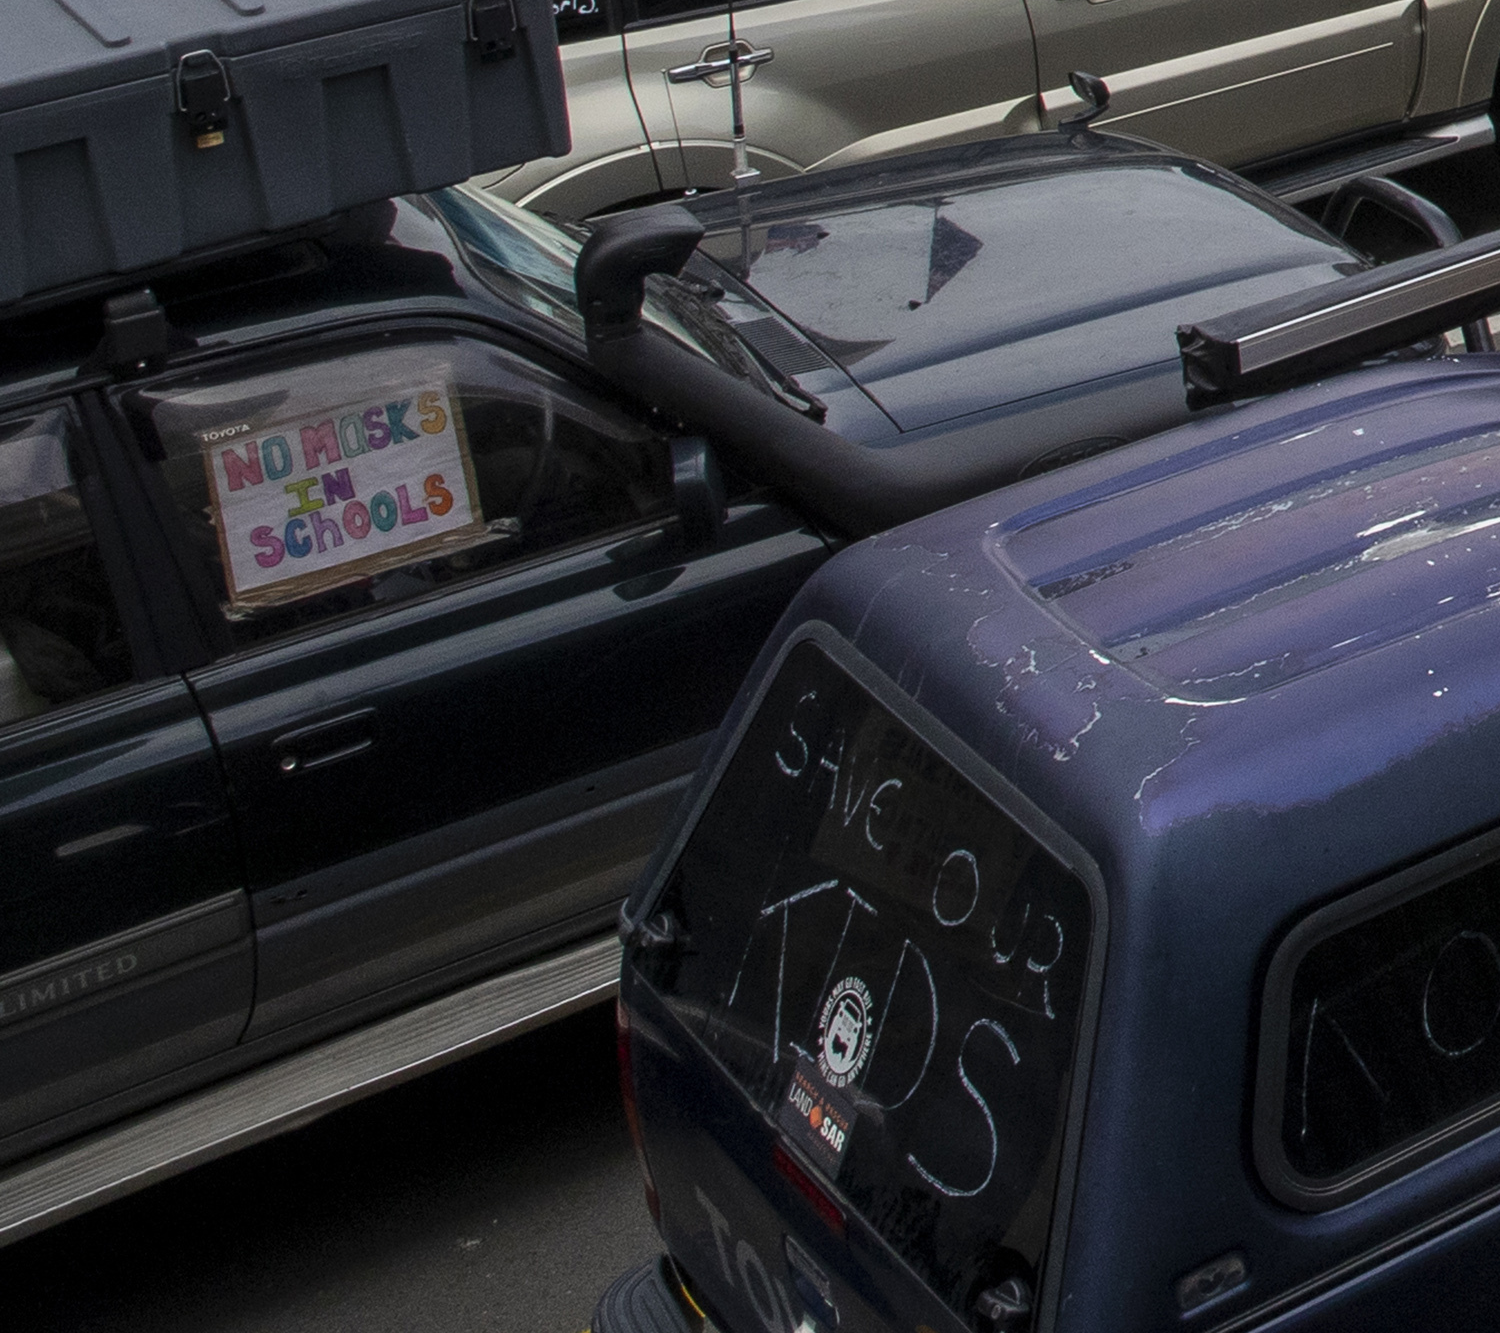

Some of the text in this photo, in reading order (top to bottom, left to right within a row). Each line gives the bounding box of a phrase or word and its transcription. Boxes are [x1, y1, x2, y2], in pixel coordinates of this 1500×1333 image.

[202, 423, 251, 442] TOYOTA
[221, 435, 293, 492] NO
[285, 467, 356, 517] IN
[775, 690, 1064, 1020] SAVE OUR
[819, 993, 834, 1029] YOURS
[817, 1051, 828, 1078] MINE
[846, 1034, 873, 1085] ANYWHERE
[789, 1083, 814, 1117] LAND
[820, 1116, 845, 1152] SAR
